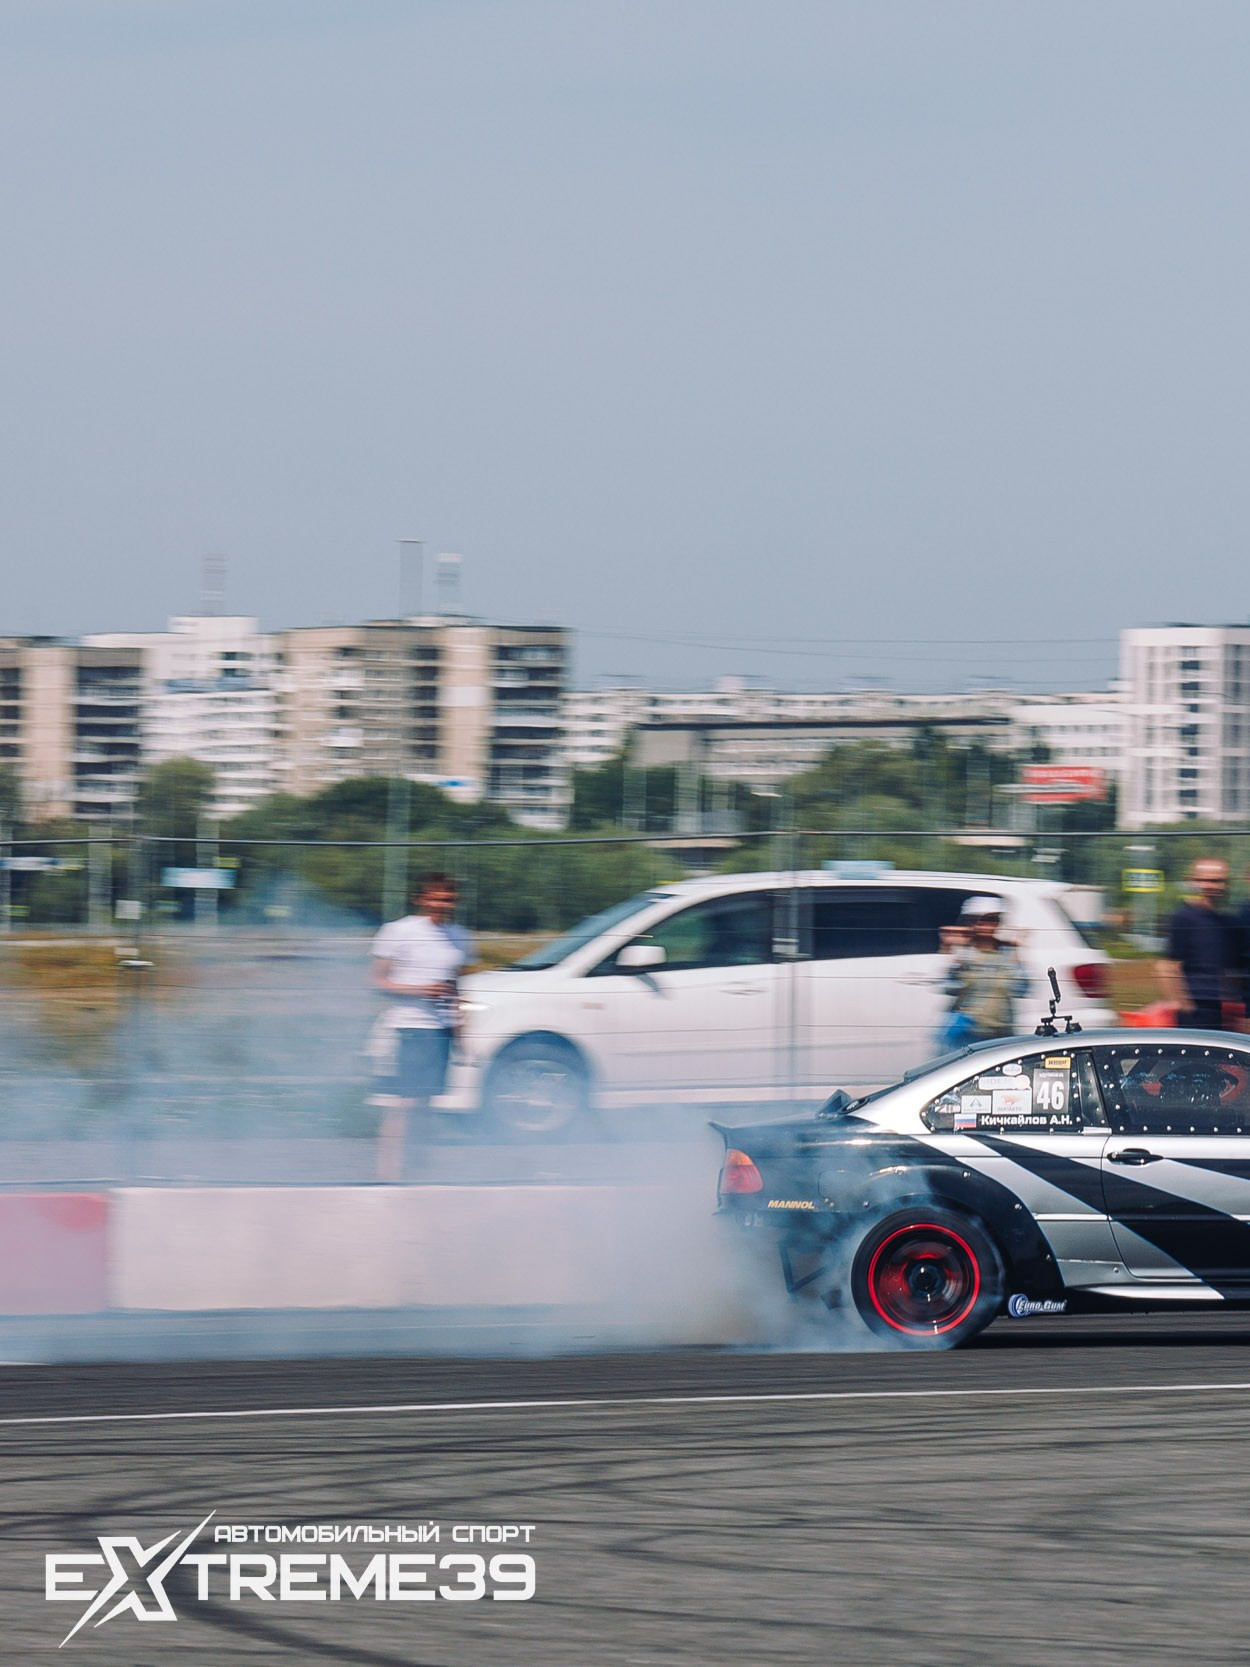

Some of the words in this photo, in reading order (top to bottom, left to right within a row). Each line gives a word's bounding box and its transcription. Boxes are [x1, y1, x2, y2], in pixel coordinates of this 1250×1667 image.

[1036, 1081, 1064, 1110] 46
[980, 1113, 1047, 1125] Кичкайлов
[1050, 1114, 1073, 1125] А.Н.
[767, 1199, 815, 1210] MANNOL
